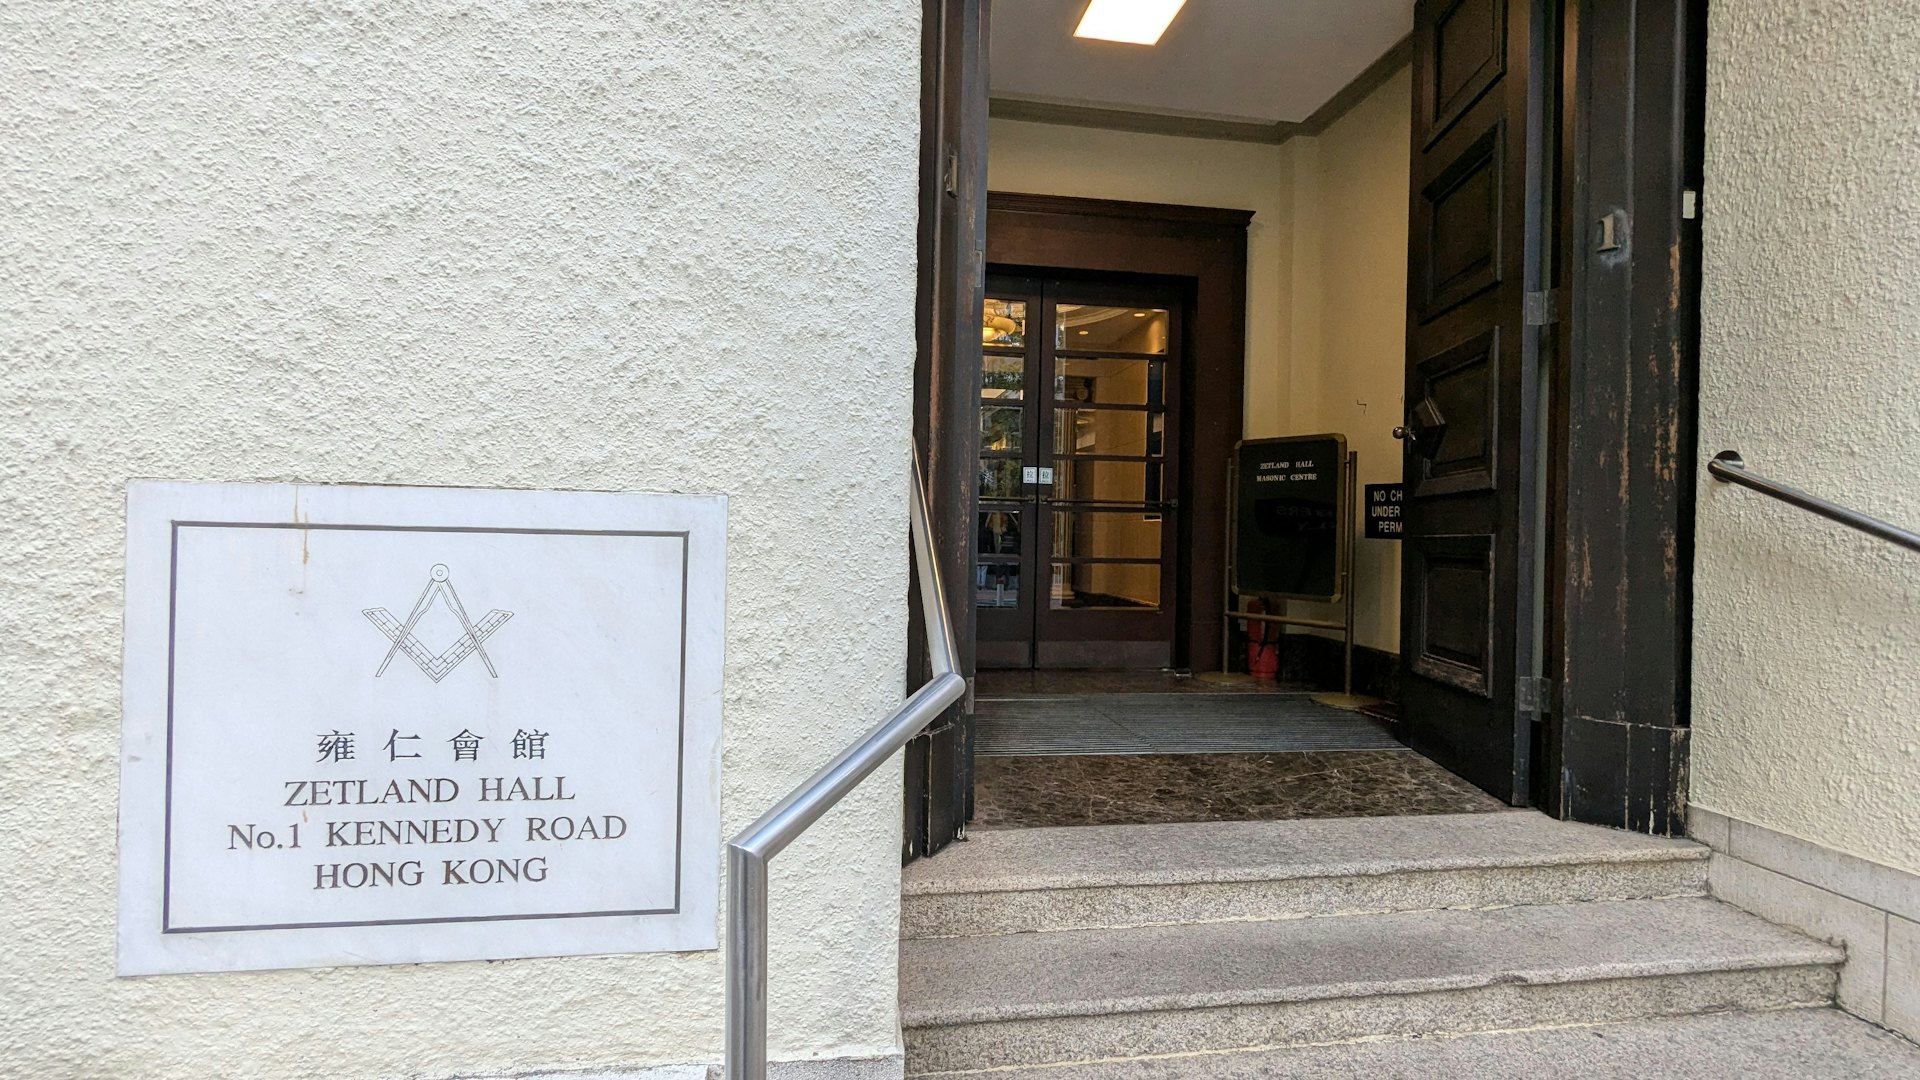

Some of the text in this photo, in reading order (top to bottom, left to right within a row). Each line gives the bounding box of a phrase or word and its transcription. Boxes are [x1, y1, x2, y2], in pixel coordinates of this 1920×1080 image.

[1596, 212, 1621, 252] 1
[1256, 473, 1318, 482] MASONIC CENTRE
[1260, 460, 1314, 470] ZETLAND HALL
[1371, 505, 1401, 517] UNDER
[1373, 490, 1386, 502] NO
[317, 728, 550, 764] 雍仁會館
[284, 776, 576, 807] ZETLAND HALL
[227, 815, 627, 850] No.1 KENNEDY ROAD
[313, 856, 549, 890] HONG KONG
